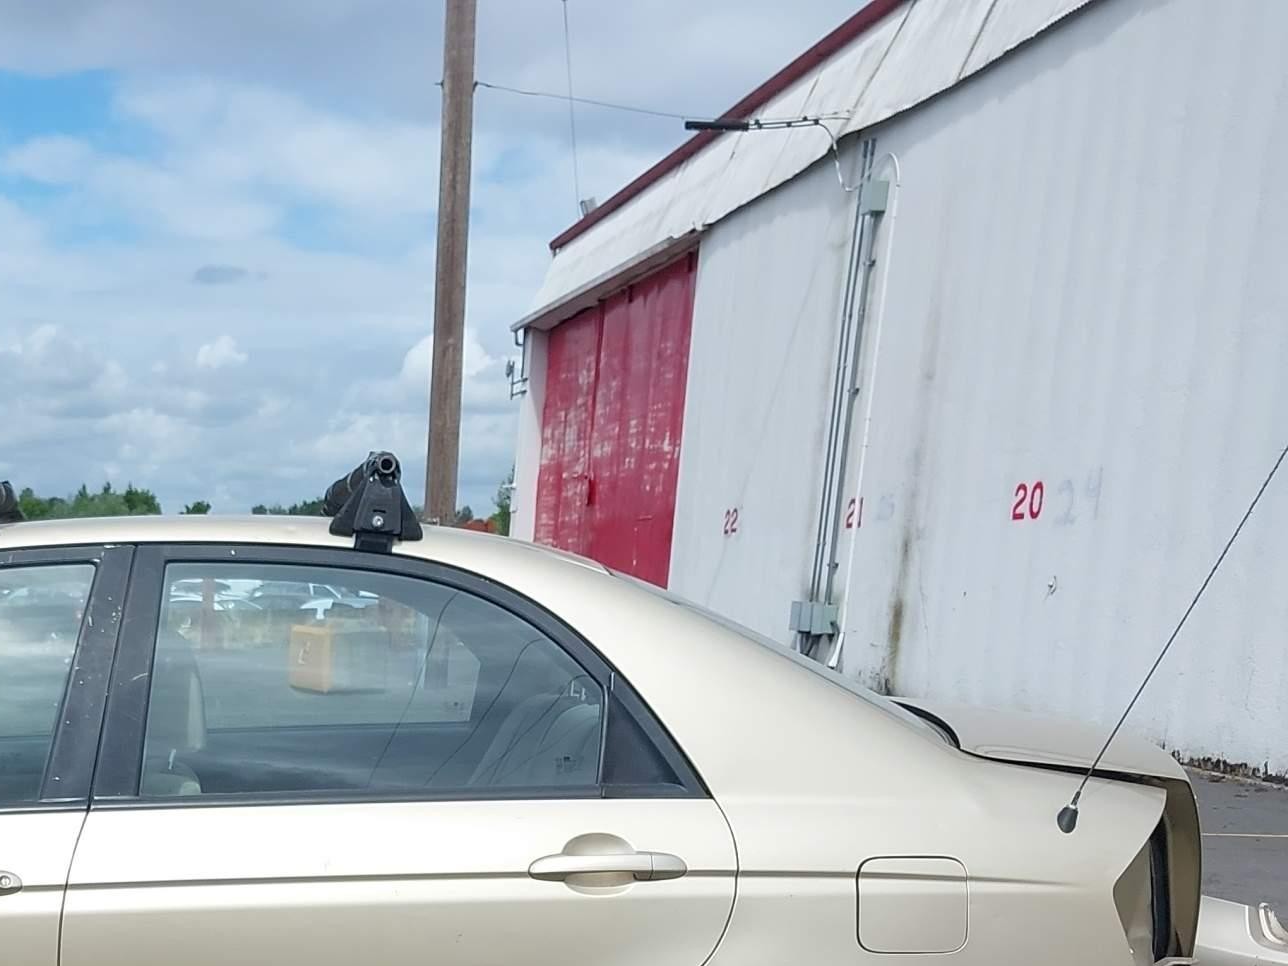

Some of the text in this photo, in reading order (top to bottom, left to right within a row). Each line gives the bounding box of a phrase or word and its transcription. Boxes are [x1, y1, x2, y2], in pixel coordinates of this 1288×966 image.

[846, 497, 864, 529] 21
[1012, 482, 1044, 520] 20
[724, 508, 739, 535] 22
